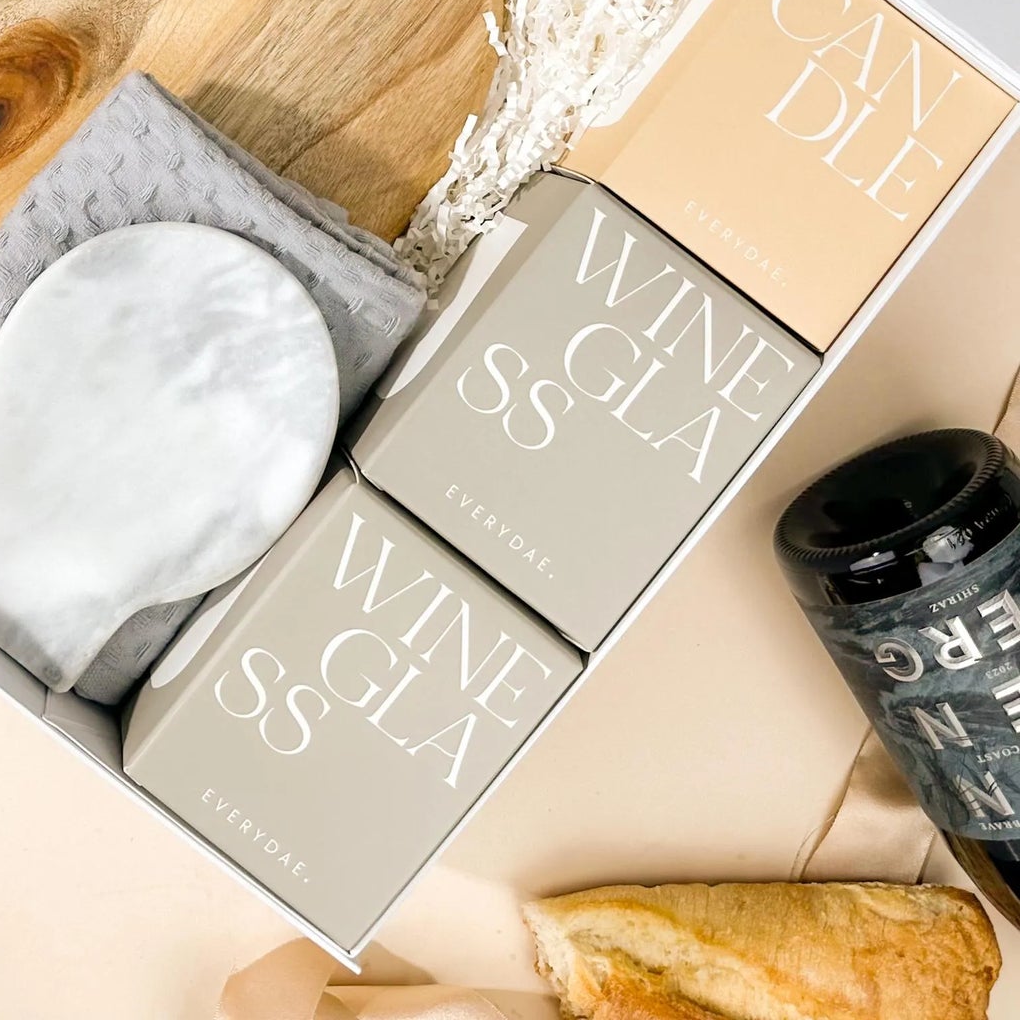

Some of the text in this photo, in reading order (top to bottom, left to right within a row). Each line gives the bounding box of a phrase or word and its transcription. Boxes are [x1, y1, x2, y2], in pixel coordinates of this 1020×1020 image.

[763, 58, 944, 222] DLE
[575, 207, 795, 422] WINE
[456, 342, 575, 450] SS
[563, 322, 722, 484] GLA
[445, 484, 555, 579] EVERYDAE.
[929, 583, 980, 614] SHIRAZ
[332, 511, 552, 728] WINE
[214, 647, 332, 755] SS
[320, 628, 478, 789] GLA
[201, 787, 311, 883] EVERYDAE.
